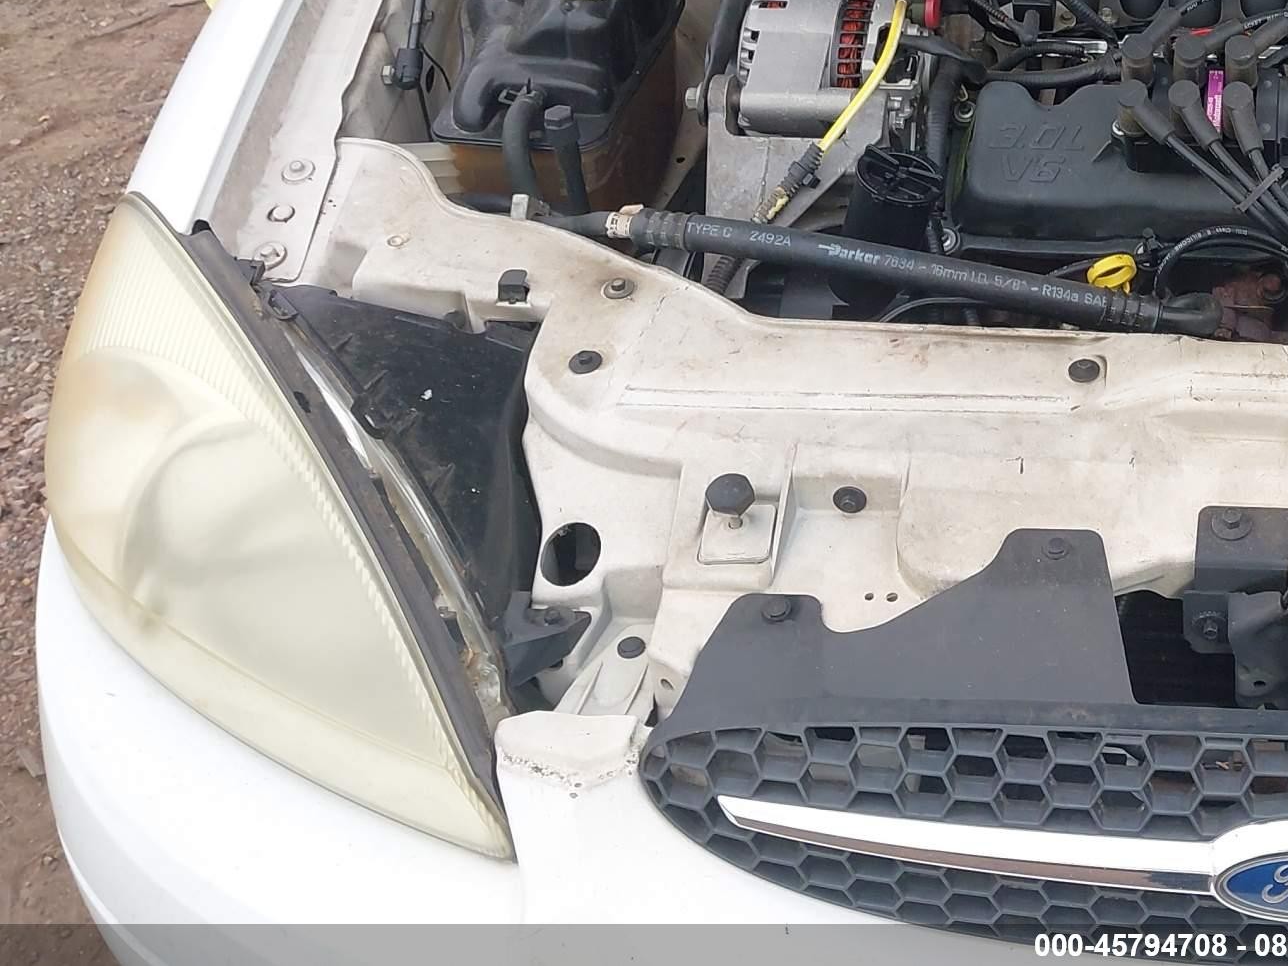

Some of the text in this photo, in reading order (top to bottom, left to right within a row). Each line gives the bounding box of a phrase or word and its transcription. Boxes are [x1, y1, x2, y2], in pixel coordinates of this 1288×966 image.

[1001, 154, 1066, 184] V6
[686, 222, 719, 236] TYPE
[749, 230, 792, 247] 2492A
[818, 242, 880, 266] Parker
[1042, 283, 1079, 302] R134a
